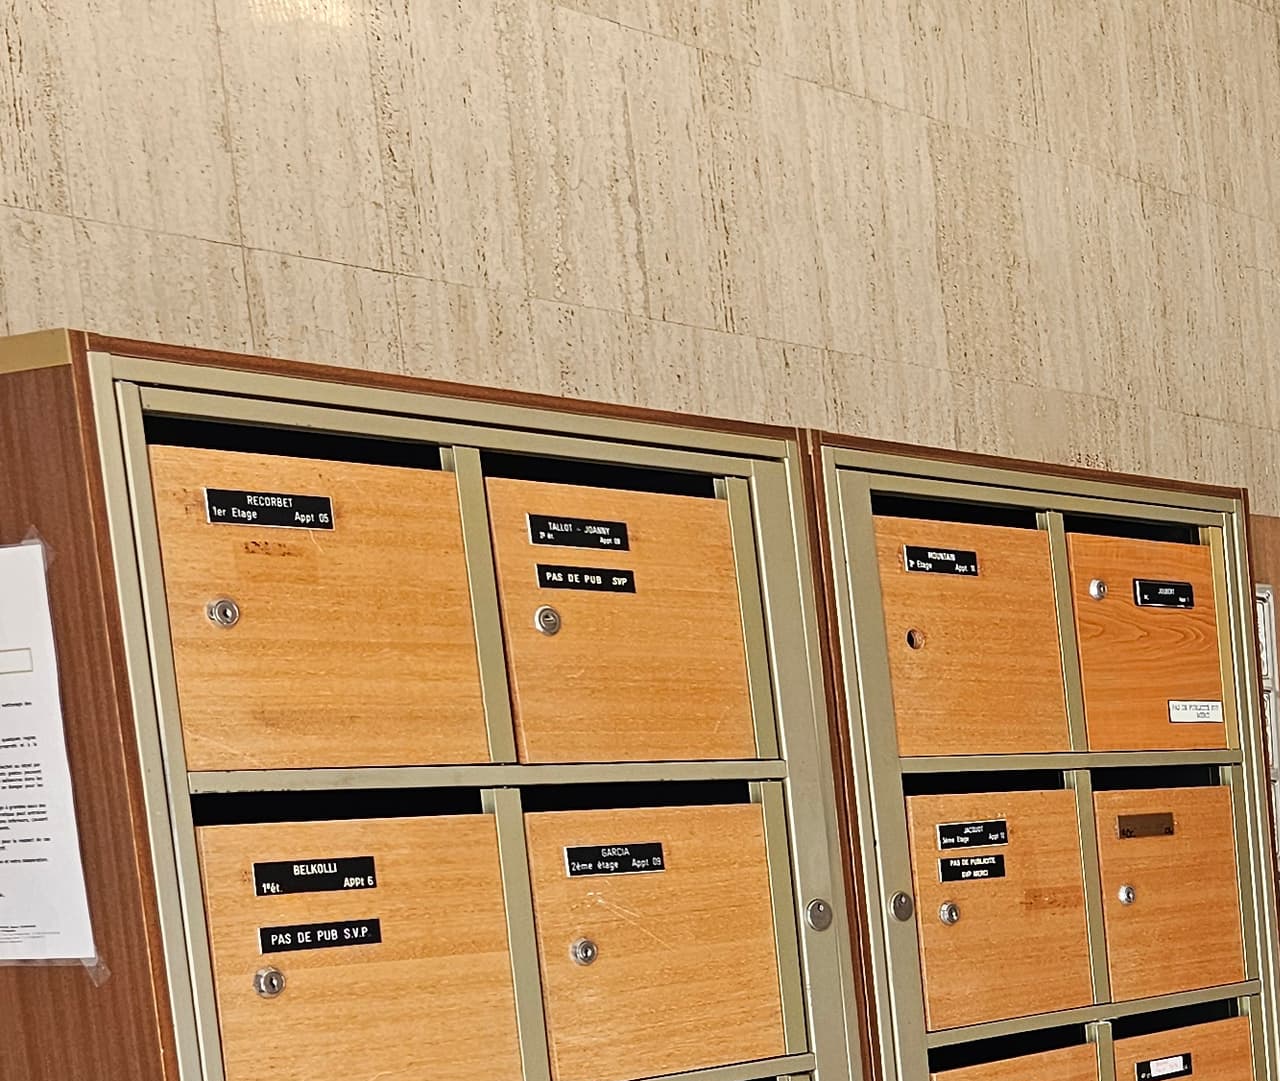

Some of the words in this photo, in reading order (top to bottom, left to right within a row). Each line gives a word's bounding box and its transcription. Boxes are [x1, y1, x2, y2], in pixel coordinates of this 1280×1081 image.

[246, 495, 293, 508] RECORBET
[212, 506, 226, 517] 1er
[231, 507, 258, 521] Etage
[294, 511, 315, 524] Appt
[545, 571, 563, 582] PAS
[567, 573, 581, 584] DE
[583, 574, 602, 585] PUB
[612, 576, 628, 586] SVP
[601, 847, 631, 858] GARCIA
[293, 862, 338, 876] BELKOLLI
[271, 932, 292, 946] PAS
[297, 931, 312, 944] DE
[316, 929, 338, 942] PUB
